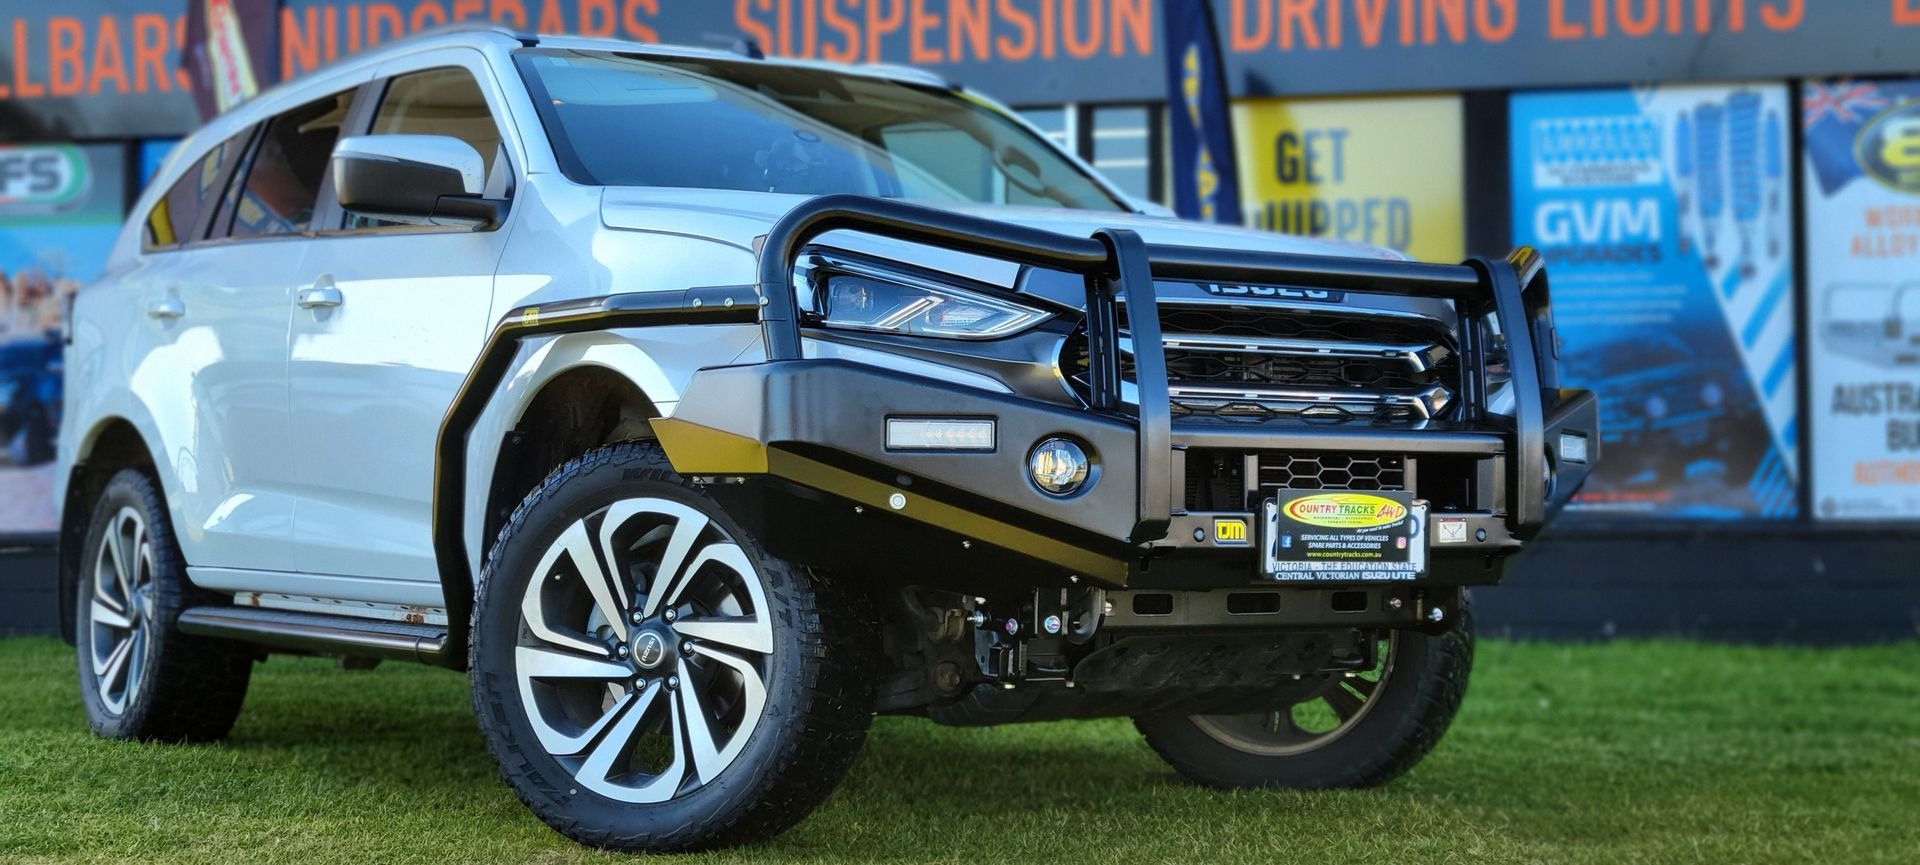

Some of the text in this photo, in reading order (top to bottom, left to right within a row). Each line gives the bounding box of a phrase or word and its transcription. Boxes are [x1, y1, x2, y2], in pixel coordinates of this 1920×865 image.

[735, 0, 1152, 65] SUSPENSION
[1231, 0, 1517, 52] DRIVING
[0, 14, 192, 97] LBAR
[1275, 130, 1350, 185] GET
[1254, 198, 1412, 251] UIPPED
[1534, 199, 1661, 244] GVM
[1831, 382, 1920, 416] AUSTR
[1339, 505, 1376, 514] TRACKS
[1376, 504, 1405, 519] 4WD
[1272, 562, 1312, 571] VICTORIA
[1322, 562, 1338, 571] THE
[1340, 562, 1390, 571] EDUCATION
[1392, 562, 1417, 571] STATE
[1276, 571, 1416, 580] CENTRAL VICTORIAN ISUZU UTE
[1306, 551, 1382, 559] www.countrytracks.com.au
